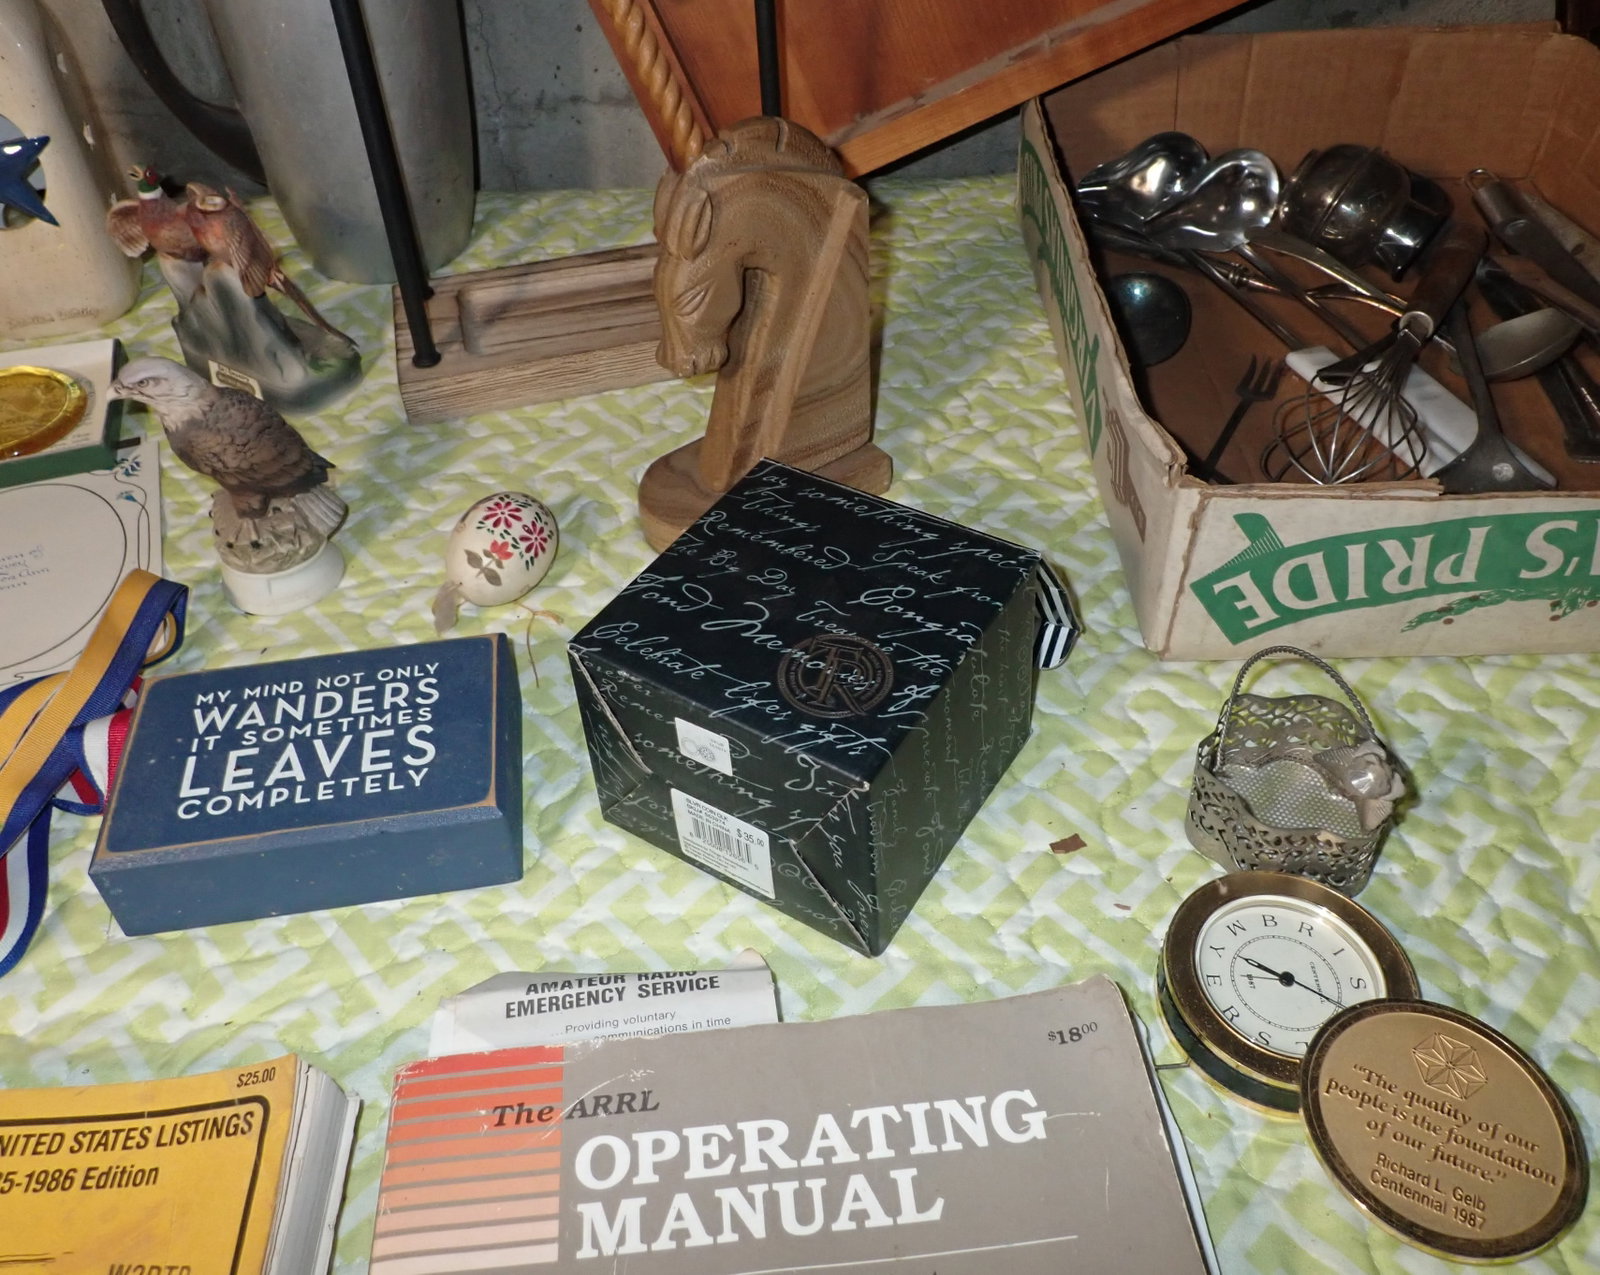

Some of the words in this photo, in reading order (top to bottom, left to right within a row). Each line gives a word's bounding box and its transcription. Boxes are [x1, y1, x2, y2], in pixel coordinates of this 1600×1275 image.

[698, 510, 864, 571] Remembered
[747, 568, 796, 601] Day
[1213, 525, 1493, 629] PRIDE
[582, 621, 722, 680] Celebrate
[193, 677, 440, 735] WANDERS
[196, 690, 231, 706] MY
[244, 681, 303, 699] MIND
[316, 672, 365, 690] NOT
[377, 662, 439, 681] ONLY
[192, 735, 221, 753] IT
[241, 707, 432, 745] SOMETIMES
[179, 724, 436, 798] LEAVES
[177, 767, 428, 820] COMPLETELY
[506, 986, 626, 1018] EMERGENCY
[638, 976, 720, 998] SERVICE
[525, 974, 626, 996] AMATEUR
[623, 1011, 676, 1025] voluntary
[692, 1021, 702, 1030] in
[707, 1017, 731, 1028] time
[236, 1066, 277, 1088] $25.00
[69, 1126, 152, 1154] STATES
[156, 1111, 255, 1148] LISTINGS
[492, 1103, 554, 1128] The
[565, 1090, 661, 1120] ARRL
[1323, 1077, 1389, 1113] people
[1392, 1103, 1408, 1121] is
[1411, 1113, 1443, 1136] the
[1444, 1127, 1557, 1186] foundation
[1403, 1090, 1472, 1128] quality
[1477, 1121, 1503, 1142] of
[1504, 1132, 1540, 1153] our
[575, 1089, 1048, 1191] OPERATING
[1366, 1119, 1392, 1140] of
[1392, 1131, 1427, 1151] our
[80, 1166, 160, 1191] Edition
[1369, 1168, 1447, 1215] Centennial
[1452, 1206, 1486, 1230] 1987
[1375, 1152, 1431, 1188] Richard
[1433, 1178, 1446, 1196] L.
[1452, 1185, 1486, 1212] Gelb
[576, 1168, 945, 1260] MANUAL
